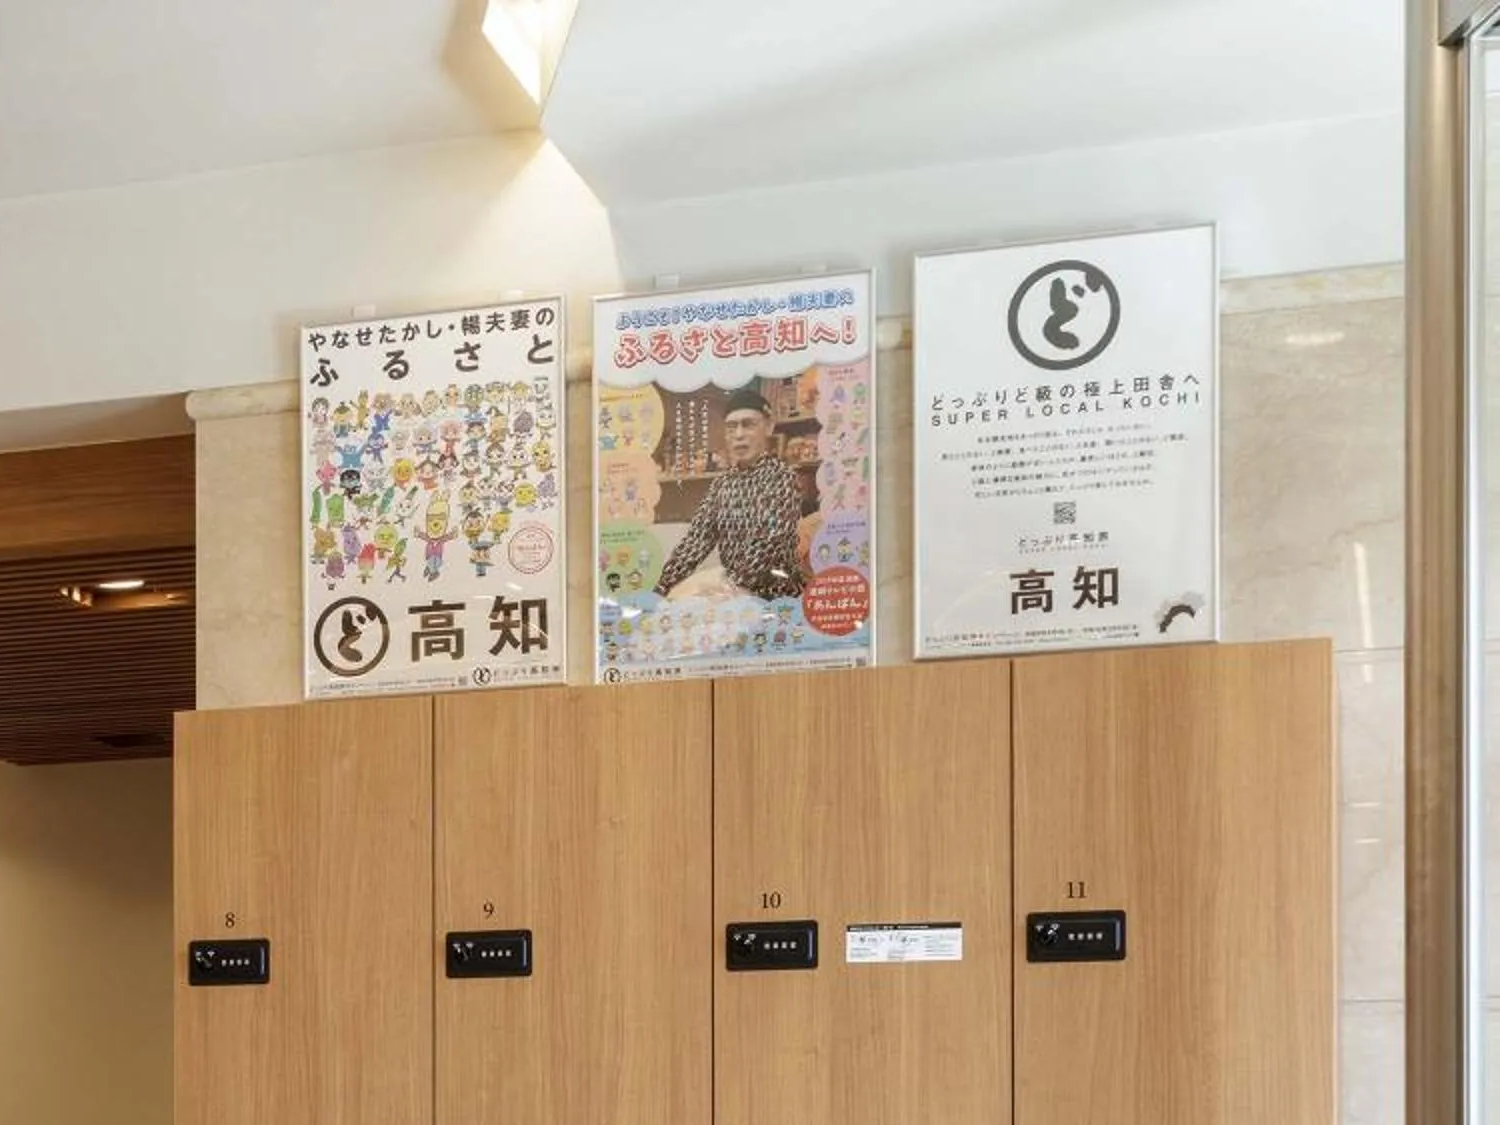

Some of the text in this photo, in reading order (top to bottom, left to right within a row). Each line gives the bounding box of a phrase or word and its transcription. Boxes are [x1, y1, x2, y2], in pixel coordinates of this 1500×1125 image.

[309, 333, 555, 388] ふるさと
[931, 374, 1201, 411] どっぷりど級の極上田舎へ
[931, 391, 1201, 427] SUPER LOCAL KOCHI
[1009, 565, 1120, 615] 高知
[407, 595, 549, 663] 高知
[761, 891, 782, 909] 10
[1067, 881, 1088, 899] 11
[224, 911, 236, 929] 8
[483, 901, 495, 920] 9
